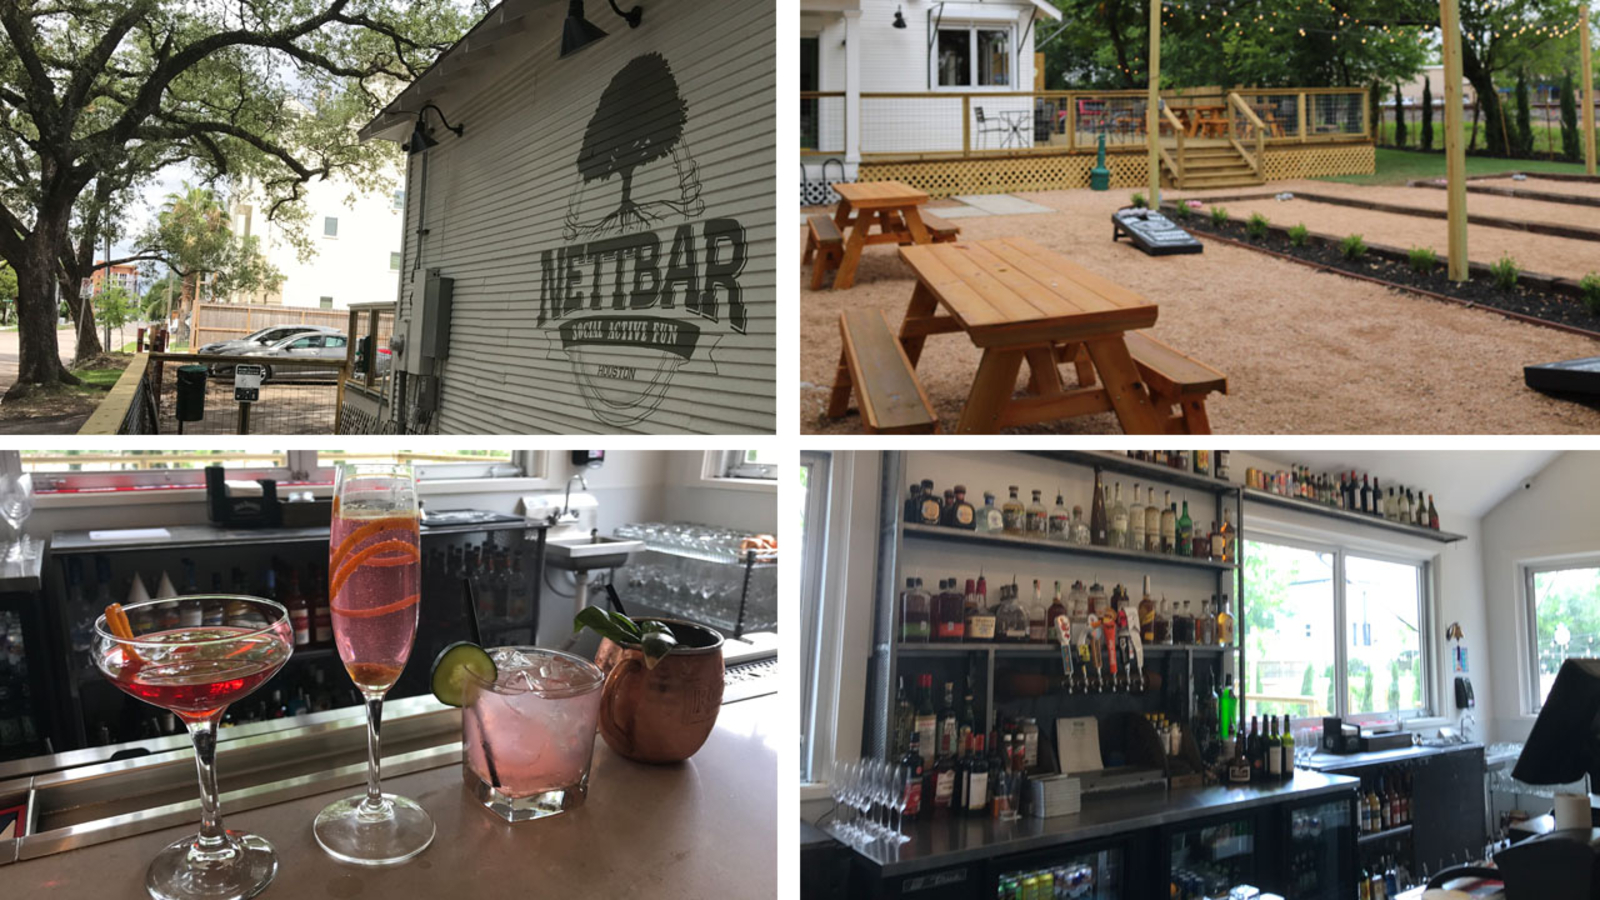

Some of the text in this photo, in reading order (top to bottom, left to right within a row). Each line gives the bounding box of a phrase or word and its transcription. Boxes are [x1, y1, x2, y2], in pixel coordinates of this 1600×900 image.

[537, 218, 748, 335] NETTBAR
[572, 321, 678, 345] SOCIAL ACTIVE FUN
[597, 364, 636, 381] HOUSTON
